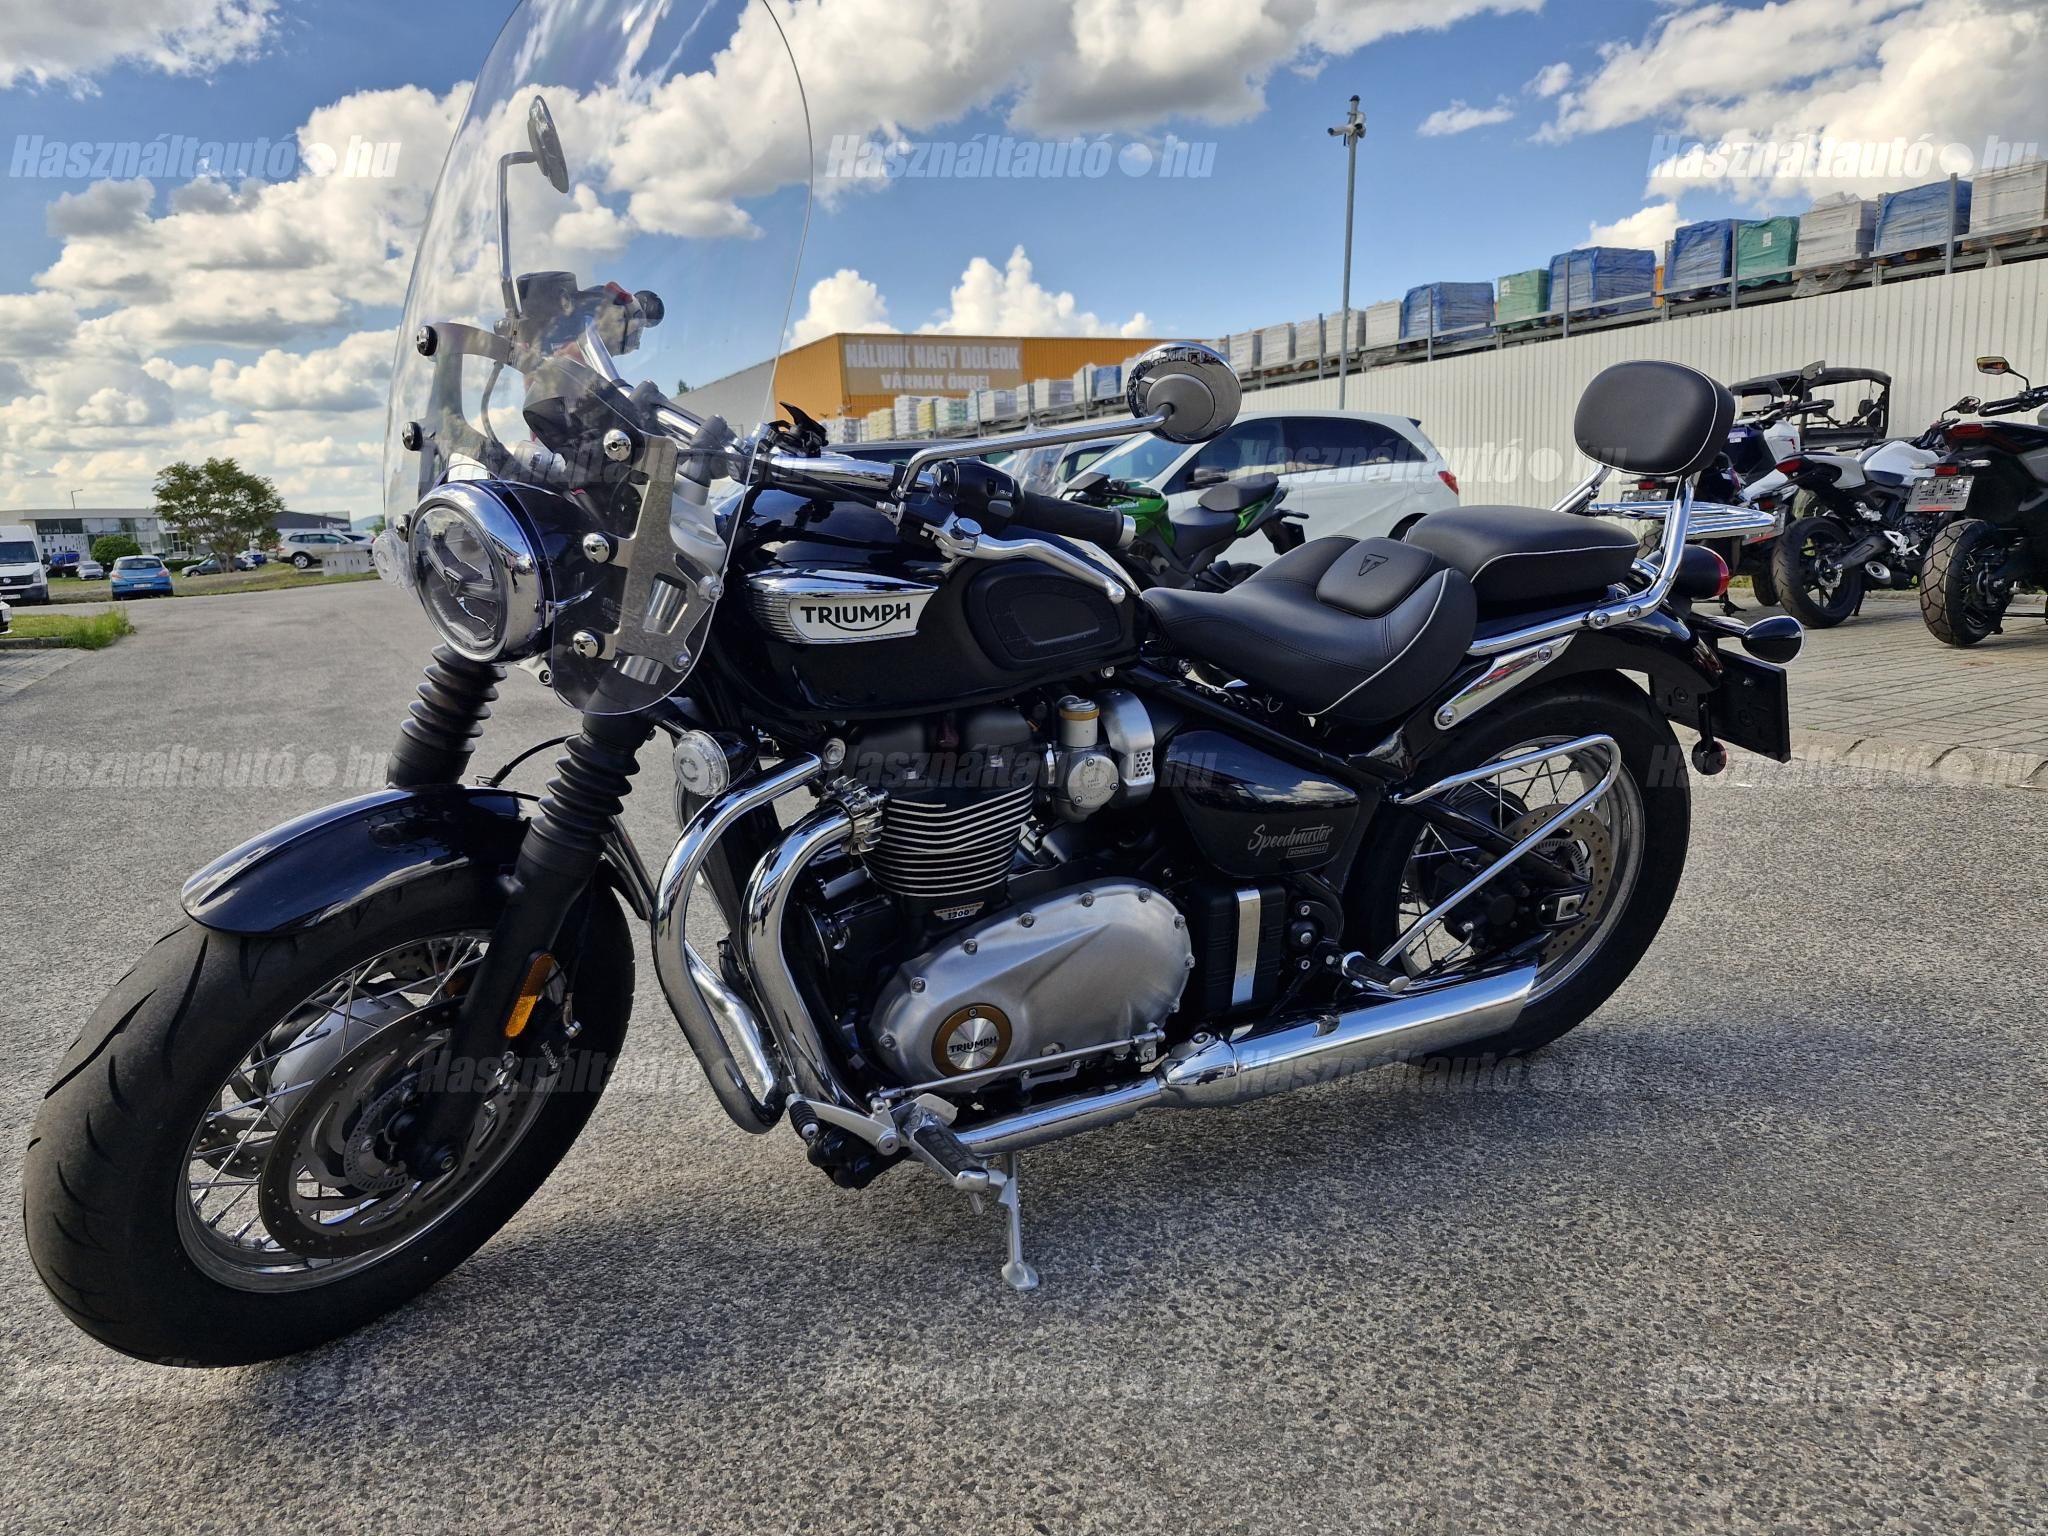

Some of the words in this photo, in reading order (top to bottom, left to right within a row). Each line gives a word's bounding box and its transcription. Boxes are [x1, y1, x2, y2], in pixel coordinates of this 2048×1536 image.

[845, 340, 911, 368] NÁLUNK
[914, 345, 958, 369] NAGY
[960, 346, 1020, 369] DOLGOK
[880, 372, 944, 389] VÁRNAK
[800, 603, 911, 631] TRIUMPH
[1248, 824, 1334, 856] Speedmaster
[949, 1036, 997, 1053] TRIUMPH
